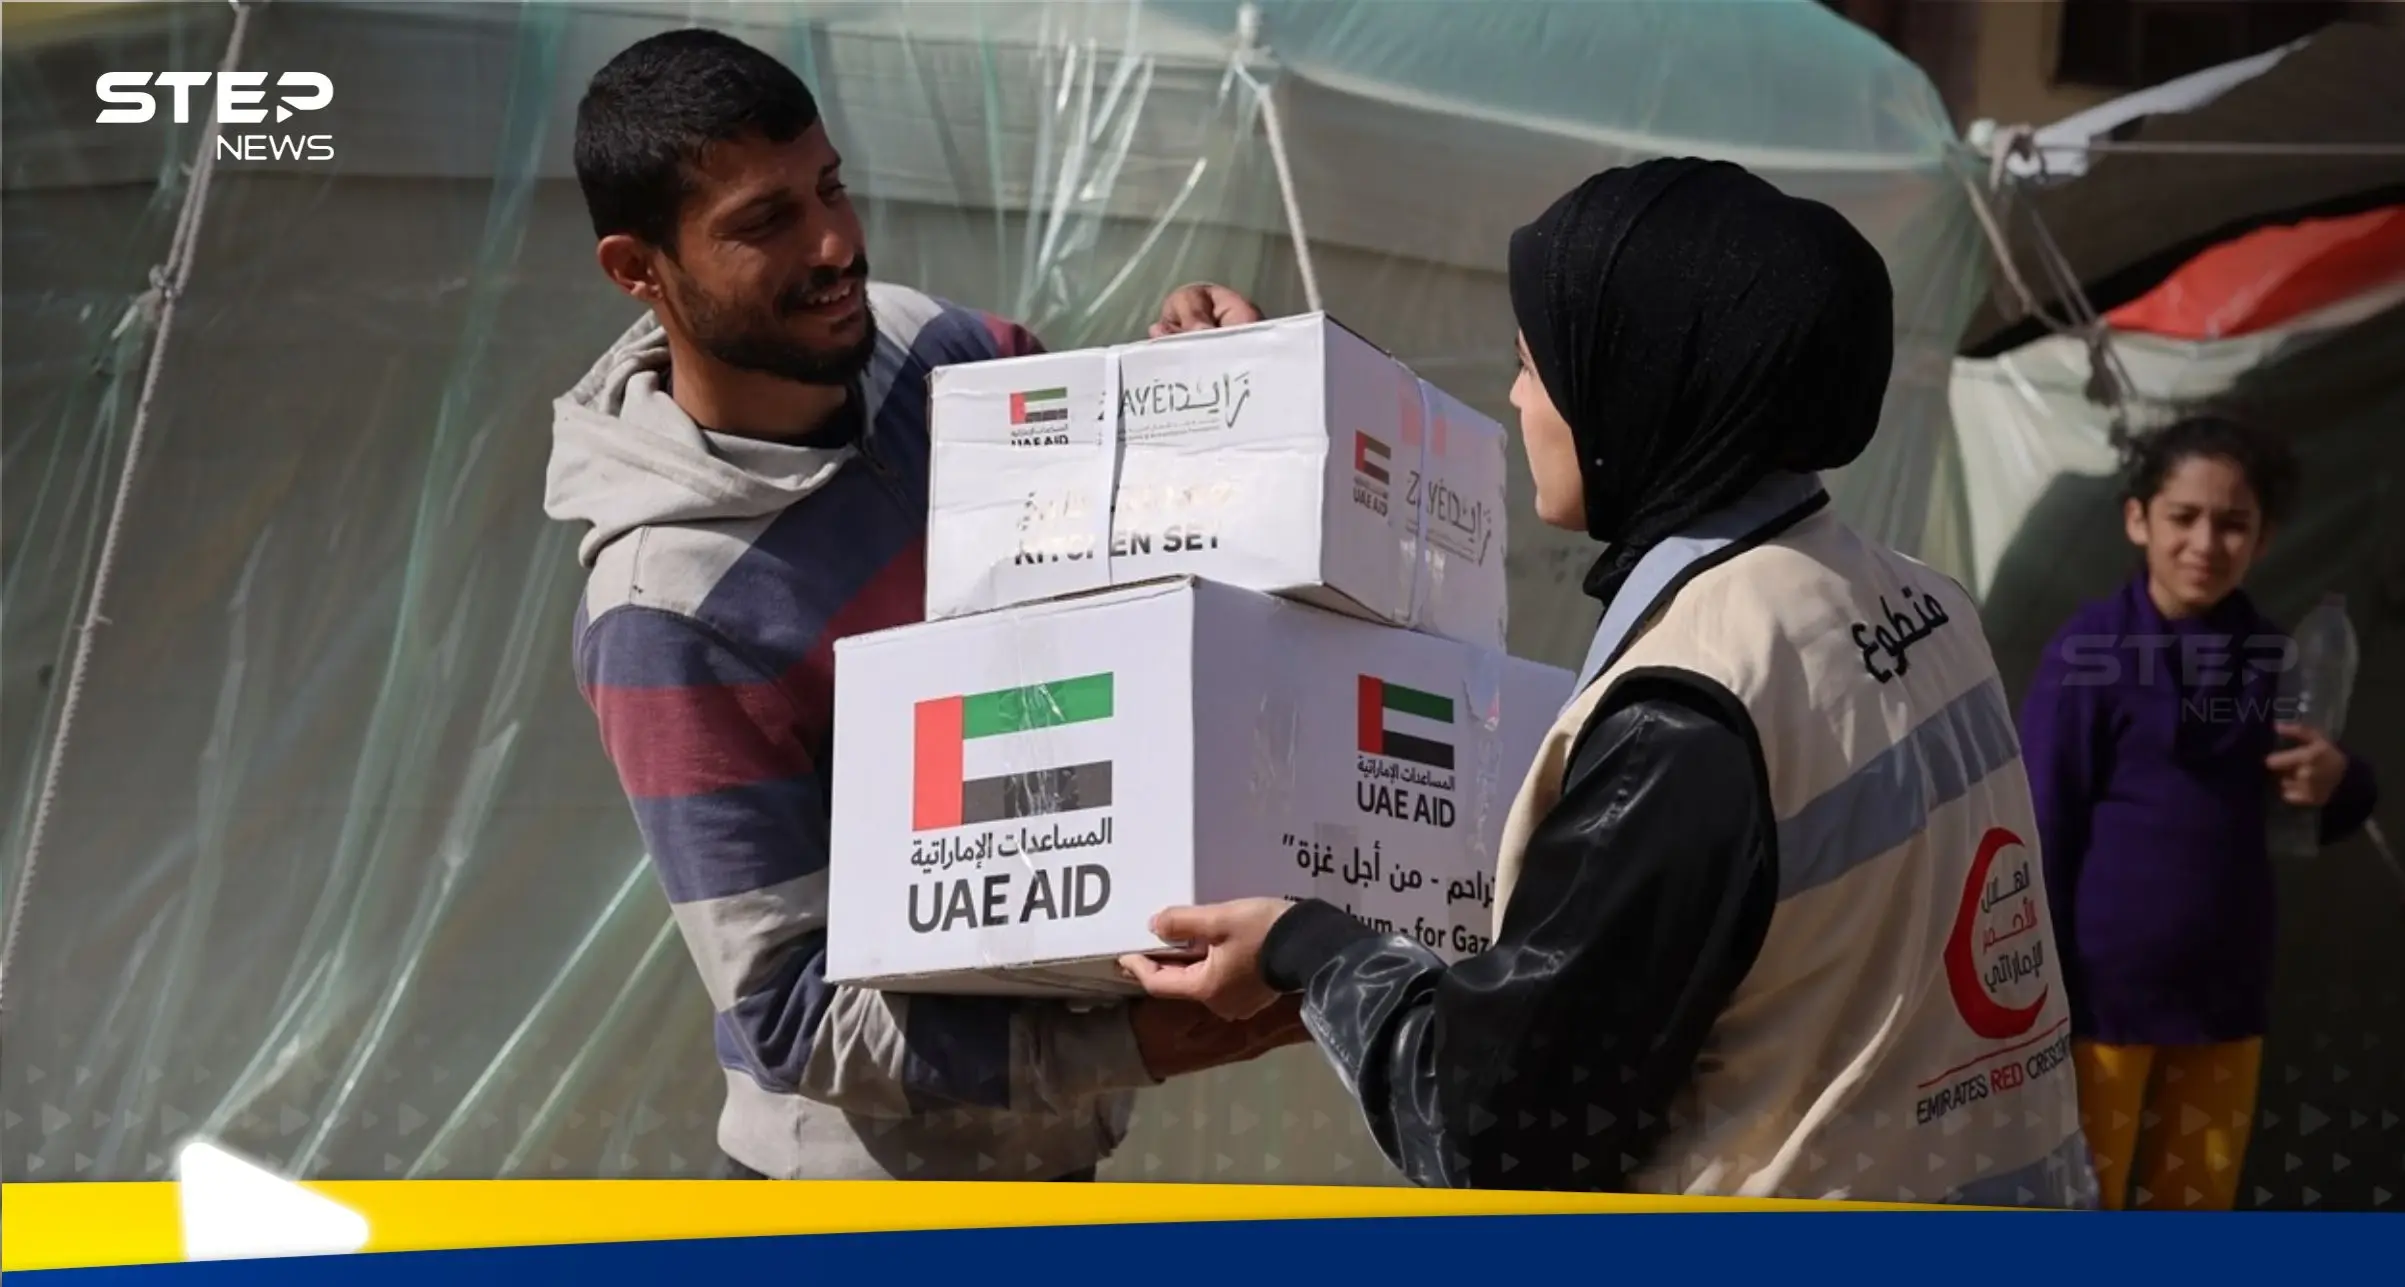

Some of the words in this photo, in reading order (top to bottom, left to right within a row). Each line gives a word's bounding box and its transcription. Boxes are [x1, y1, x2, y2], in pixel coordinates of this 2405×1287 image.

[1357, 755, 1399, 785] الإماراتية
[1400, 767, 1455, 792] المساعدات
[1357, 780, 1409, 820] UAE
[1413, 793, 1456, 829] AID
[910, 832, 993, 875] الإماراتية
[998, 816, 1113, 857] المساعدات
[1343, 840, 1380, 888] أجل
[1390, 863, 1422, 892] من
[908, 873, 1011, 934] UAE
[1019, 863, 1111, 925] AID
[1415, 917, 1447, 948] for
[1916, 1073, 1989, 1125] EMIRATES
[1990, 1062, 2024, 1097] RED
